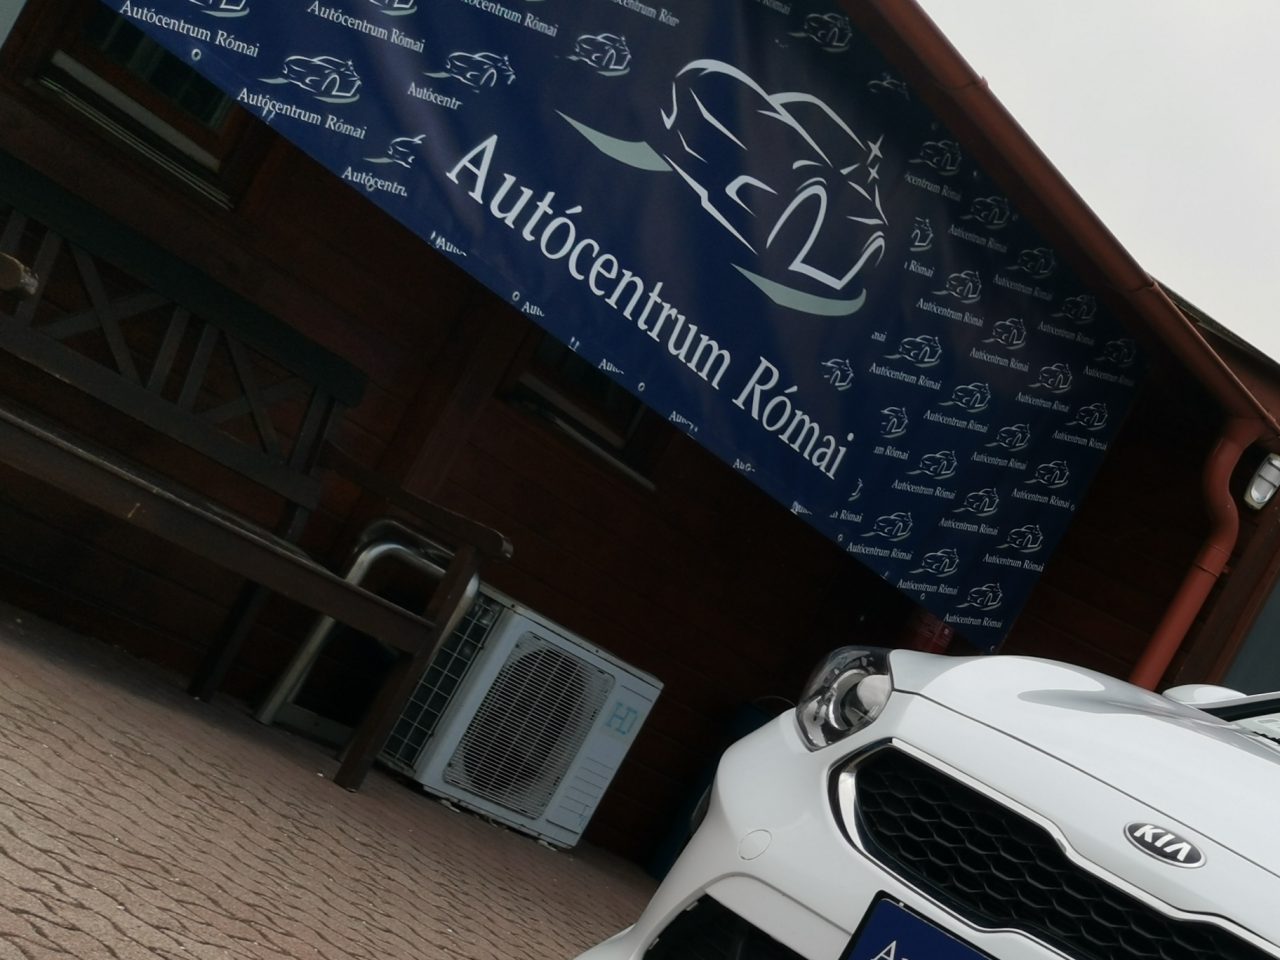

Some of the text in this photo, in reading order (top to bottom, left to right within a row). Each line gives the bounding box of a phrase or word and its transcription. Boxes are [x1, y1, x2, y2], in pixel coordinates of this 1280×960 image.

[119, 0, 260, 58] Autócentrum Római
[307, 0, 426, 53] Autócentrum Római
[523, 12, 559, 38] Római
[236, 87, 368, 140] Autócentrum Római
[445, 134, 855, 481] Autócentrum Római
[1133, 824, 1192, 862] KIA
